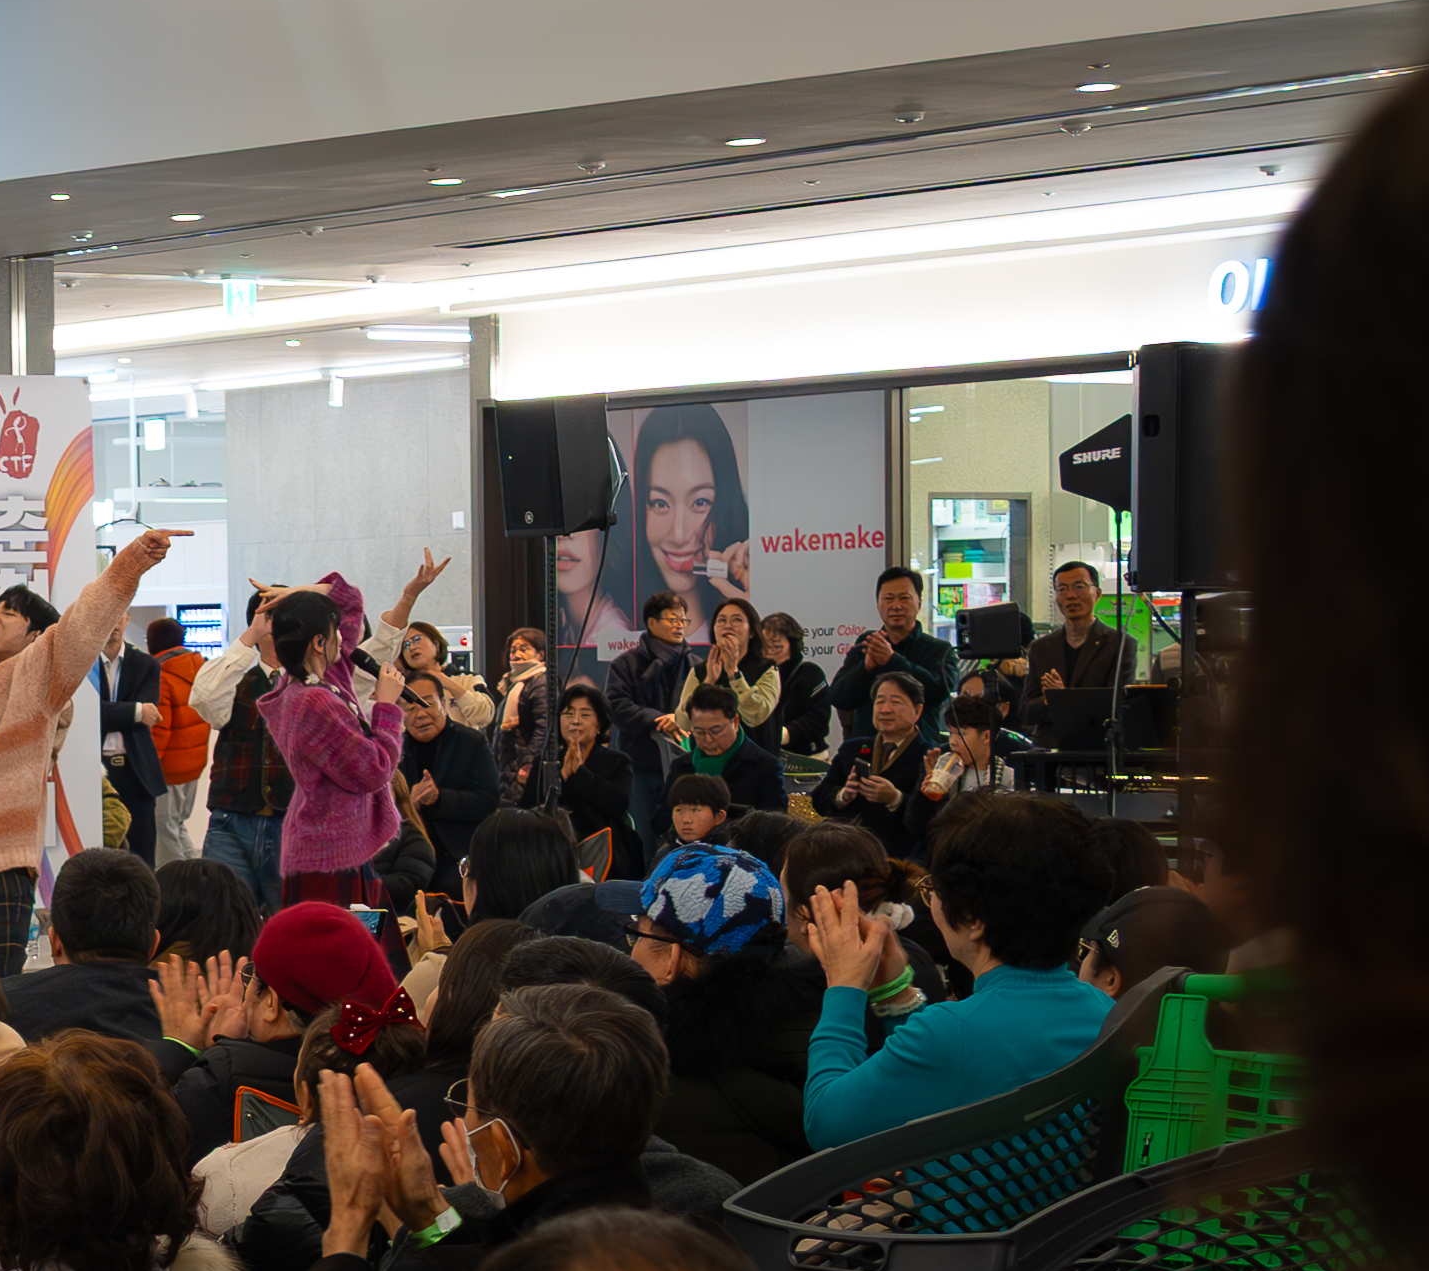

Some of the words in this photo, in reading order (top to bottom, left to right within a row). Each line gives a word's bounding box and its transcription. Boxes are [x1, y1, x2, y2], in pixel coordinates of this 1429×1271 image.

[0, 454, 33, 473] CTF
[1072, 447, 1121, 465] SHURE
[760, 524, 886, 554] wakemake
[811, 627, 835, 638] your
[607, 637, 640, 651] wake
[811, 645, 835, 657] your
